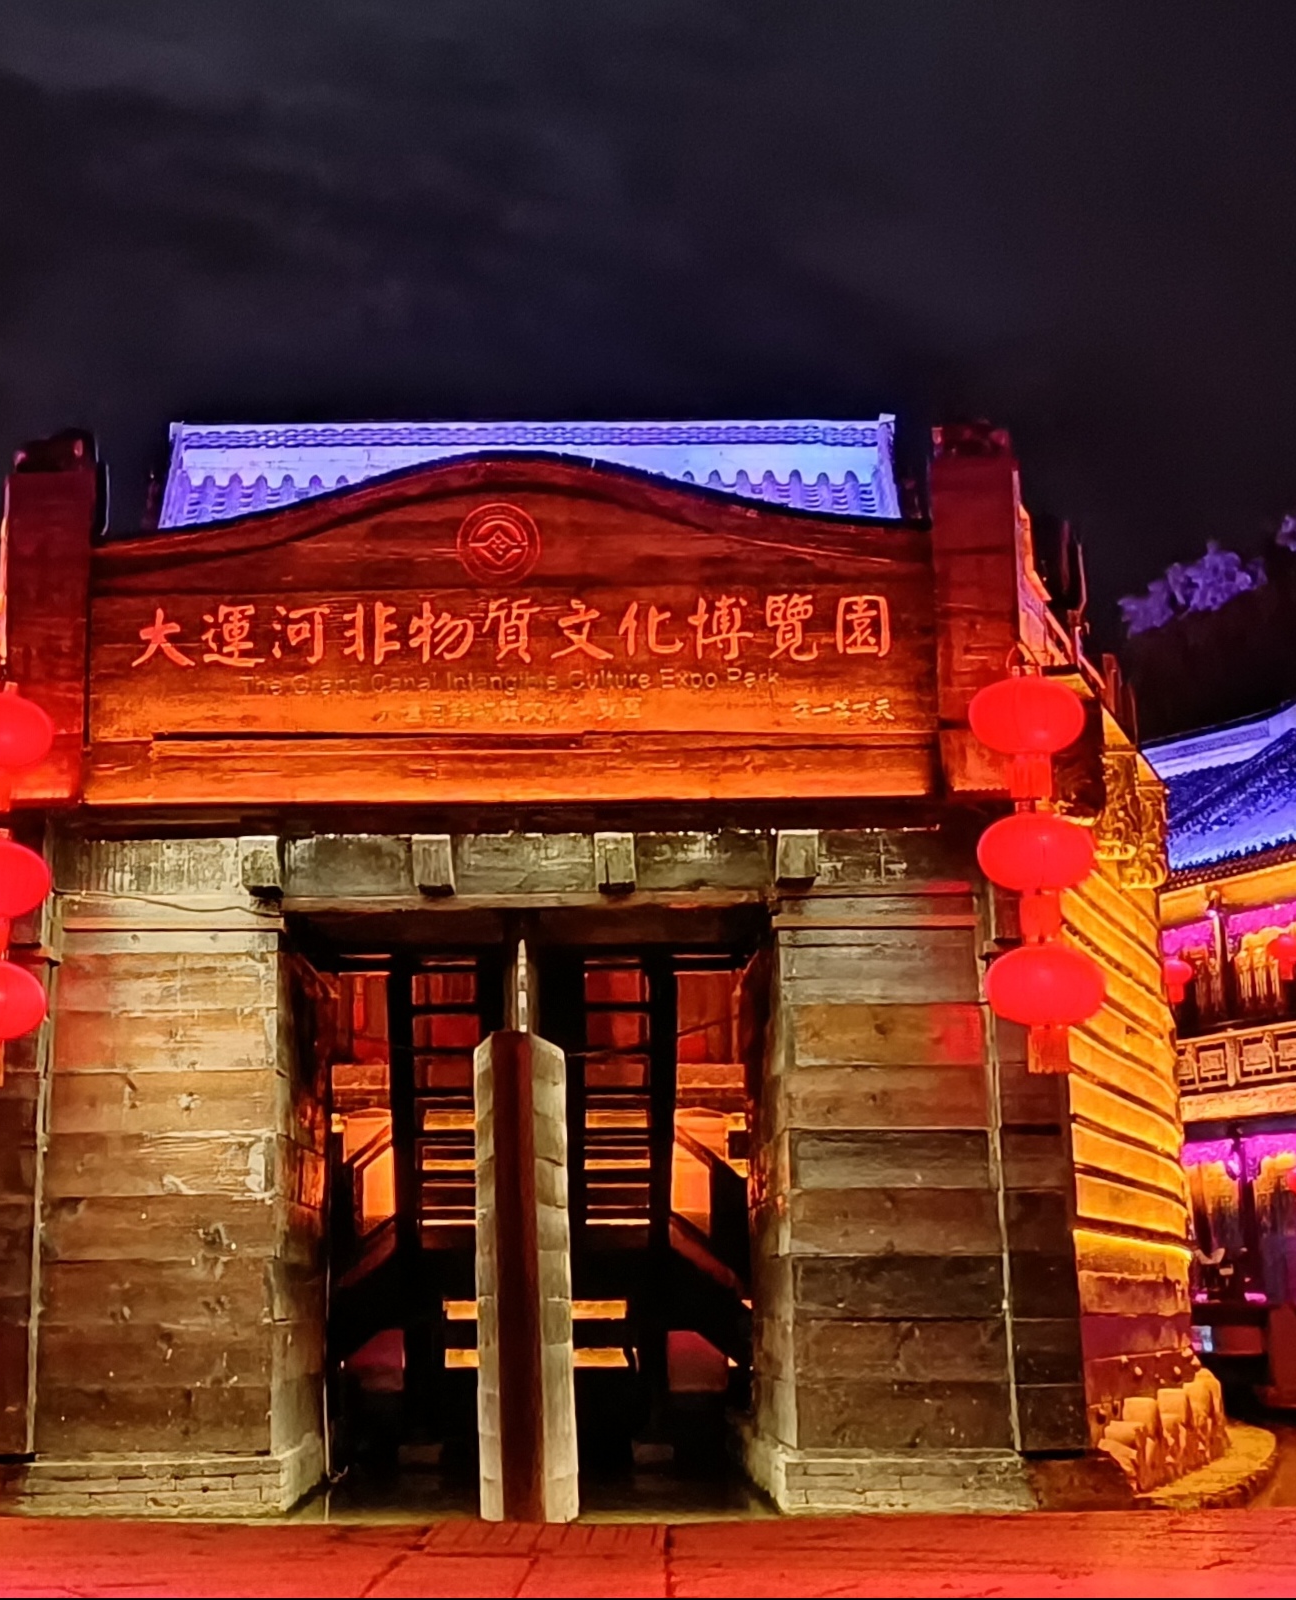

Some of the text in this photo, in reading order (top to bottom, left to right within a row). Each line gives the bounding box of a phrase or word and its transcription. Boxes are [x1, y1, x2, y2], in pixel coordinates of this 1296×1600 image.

[131, 593, 891, 668] 大運河非物質文化博覽園
[239, 674, 282, 696] The
[370, 672, 437, 693] Canal
[569, 667, 652, 691] Culture
[660, 667, 719, 691] Expo
[726, 666, 780, 689] Park
